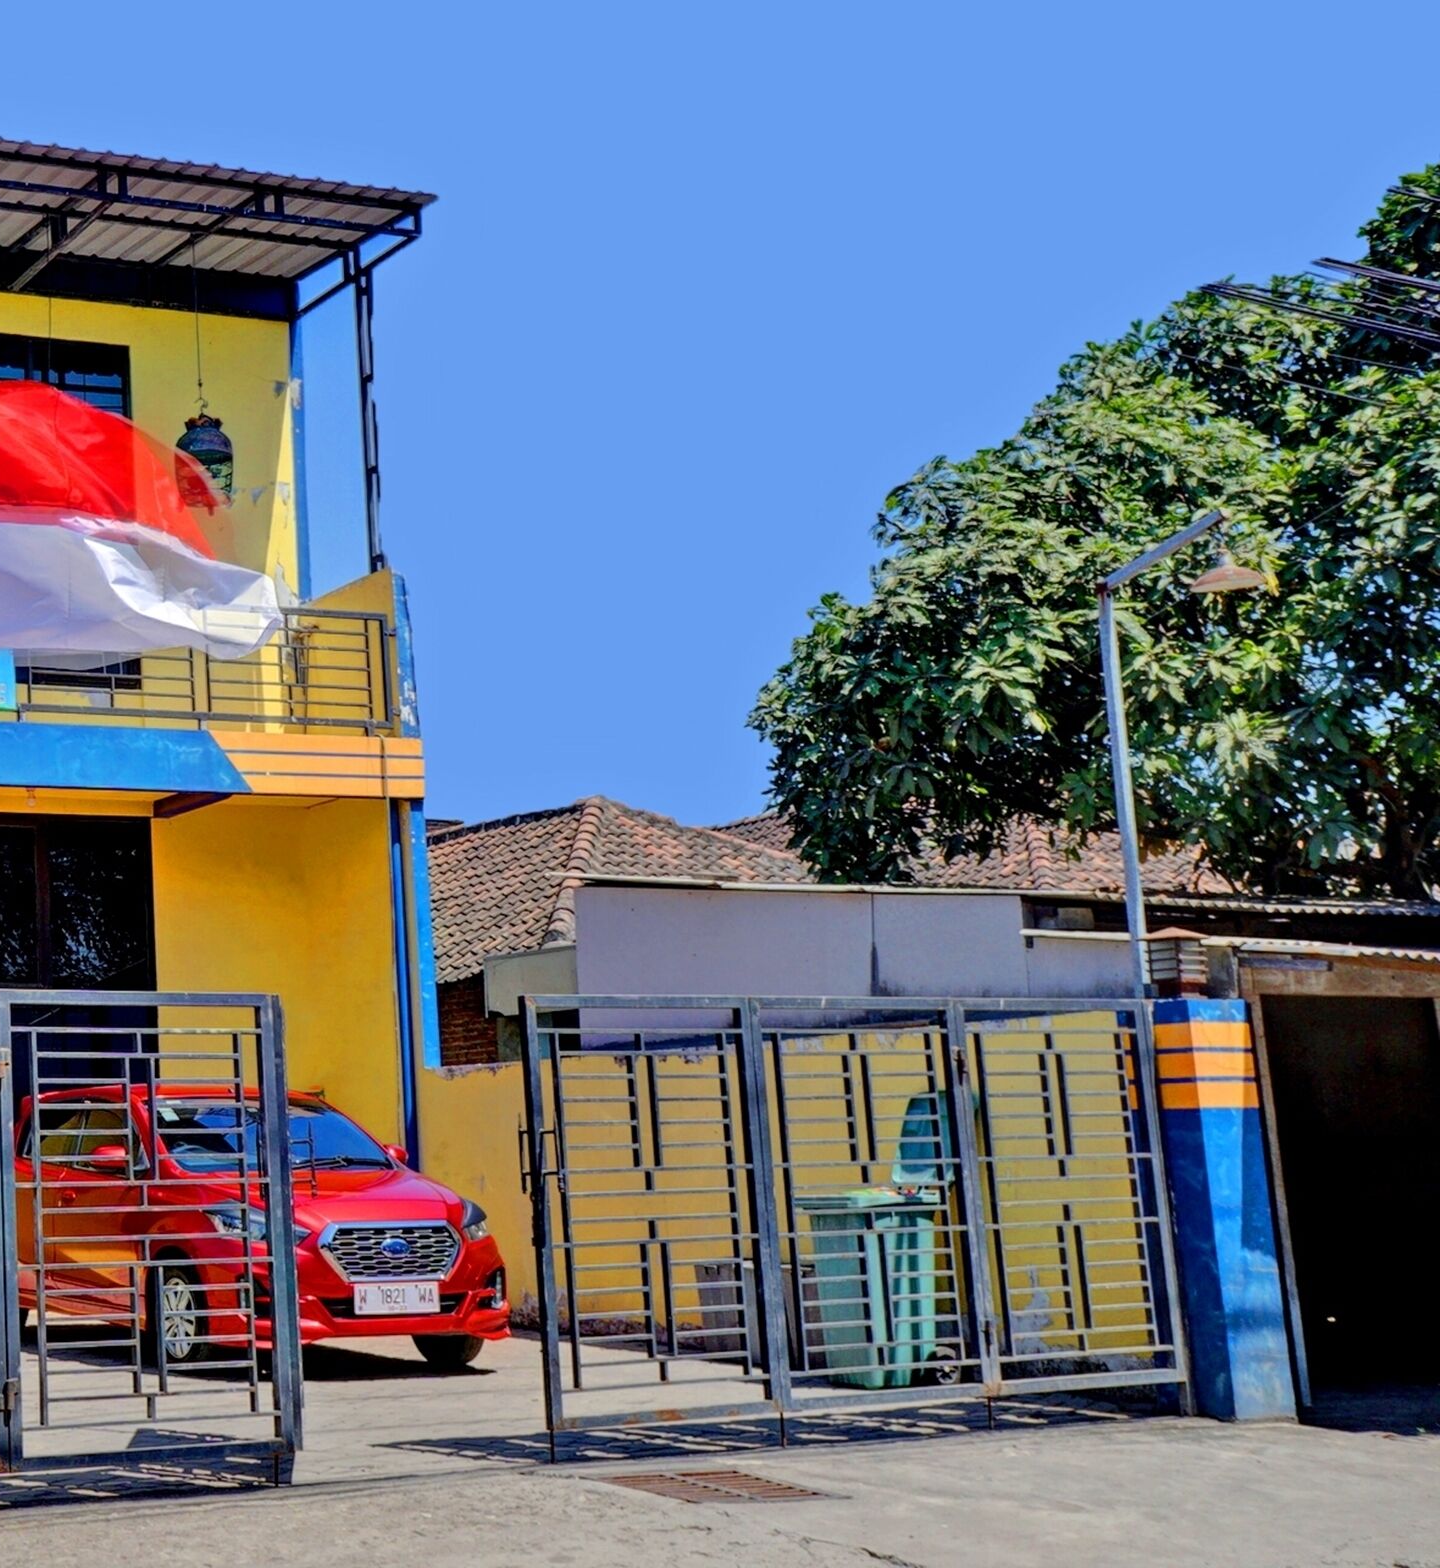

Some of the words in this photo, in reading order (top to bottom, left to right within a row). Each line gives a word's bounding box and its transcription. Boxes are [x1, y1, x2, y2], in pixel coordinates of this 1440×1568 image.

[358, 1288, 368, 1305] W
[380, 1287, 406, 1305] 1821
[418, 1287, 435, 1304] WA
